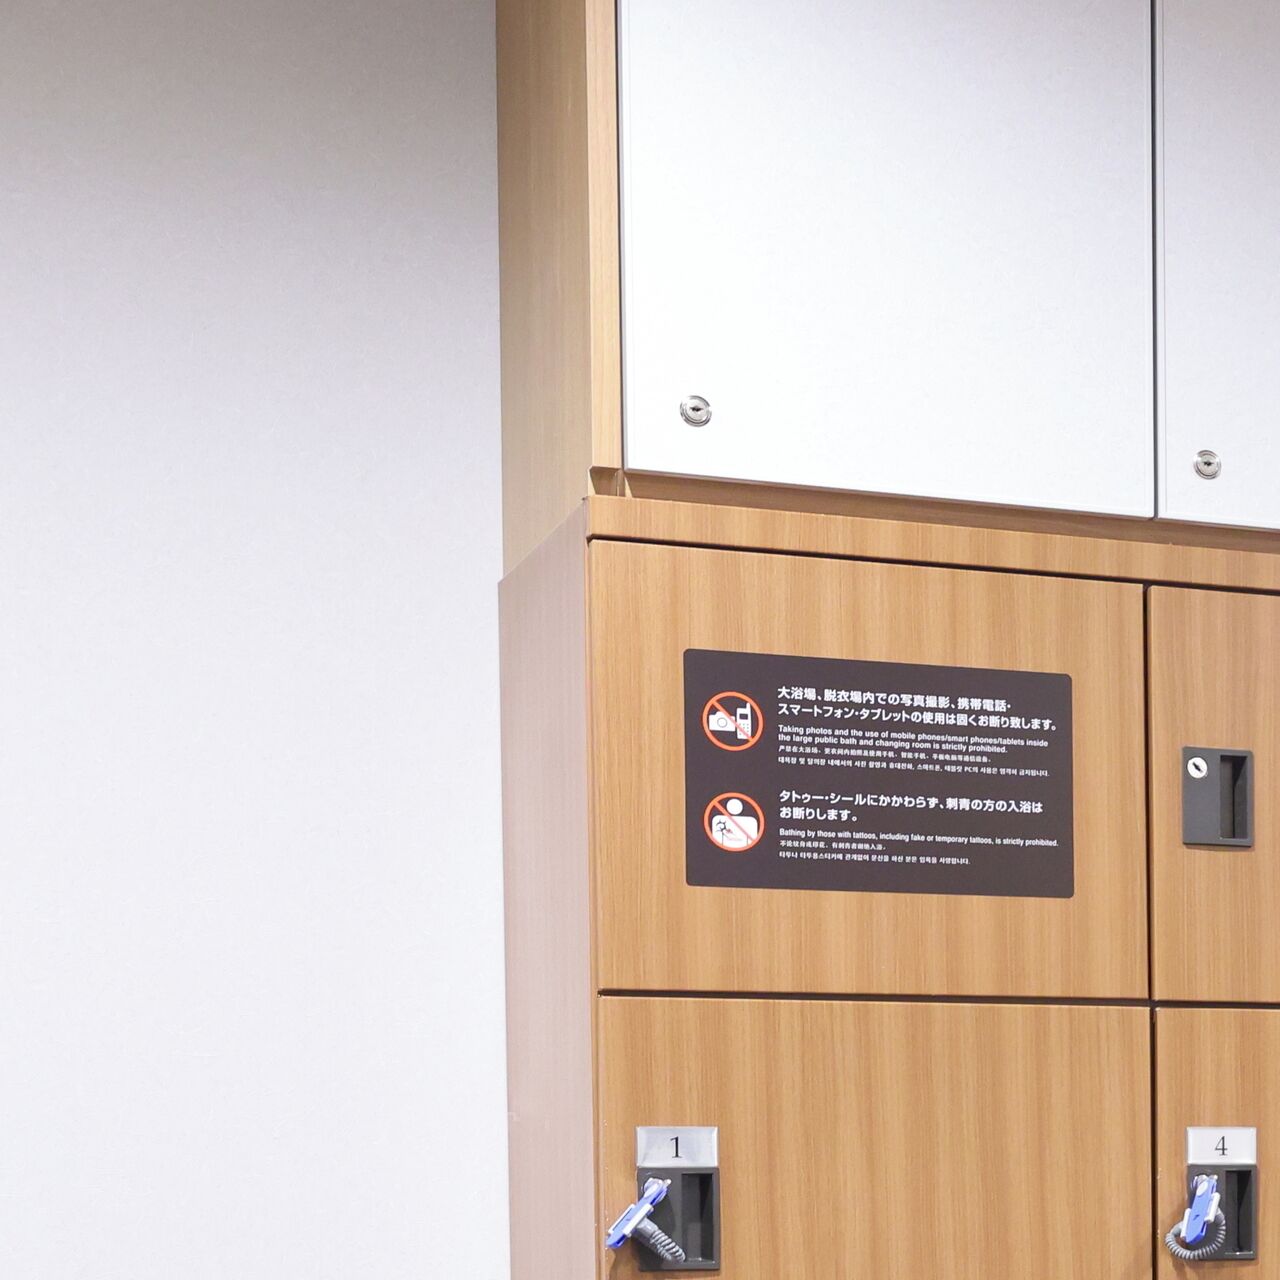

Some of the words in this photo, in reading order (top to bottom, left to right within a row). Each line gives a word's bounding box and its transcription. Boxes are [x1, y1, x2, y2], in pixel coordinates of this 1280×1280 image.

[778, 724, 804, 737] Taking
[806, 726, 832, 737] photos
[850, 729, 863, 737] the
[890, 732, 916, 740] mobile
[918, 733, 968, 743] phones/smart
[970, 736, 1025, 746] phones/tablets
[1026, 739, 1048, 747] inside
[778, 733, 791, 741] the
[793, 734, 813, 744] large
[814, 736, 838, 744] public
[840, 737, 857, 745] bath
[859, 738, 873, 746] and
[875, 738, 910, 749] changing
[942, 742, 967, 752] strictly
[968, 743, 1009, 753] prohibited.
[779, 828, 806, 838] Bathing
[807, 829, 816, 838] by
[817, 830, 836, 838] those
[879, 832, 909, 842] including
[911, 833, 925, 841] fake
[935, 835, 968, 844] temporary
[1003, 838, 1024, 847] strictly
[1025, 839, 1058, 847] prohibited.
[670, 1136, 679, 1158] 1
[1215, 1136, 1228, 1156] 4
